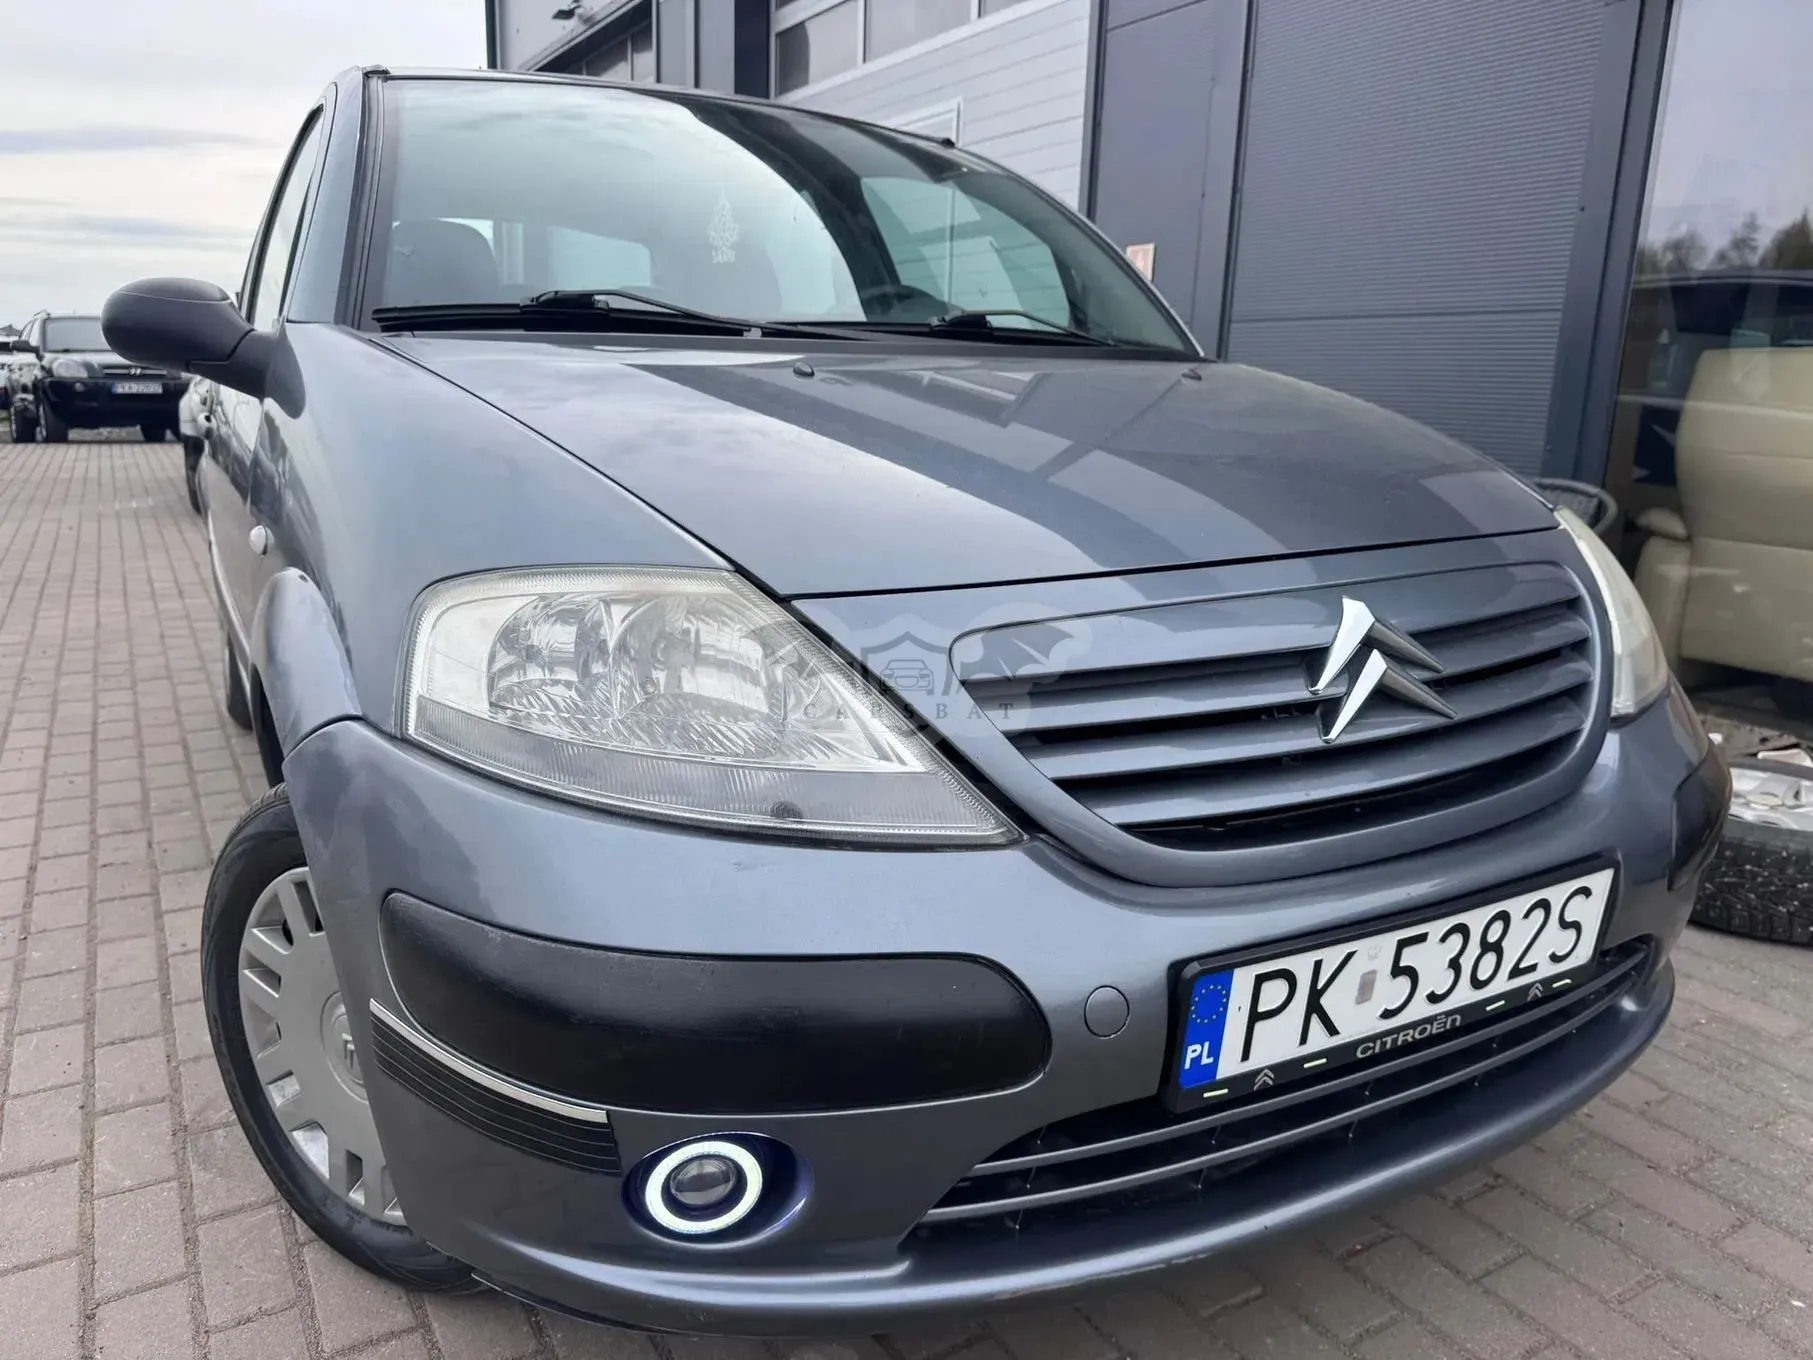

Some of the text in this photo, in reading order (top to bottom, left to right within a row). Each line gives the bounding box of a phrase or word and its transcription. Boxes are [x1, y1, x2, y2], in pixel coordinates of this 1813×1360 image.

[1240, 886, 1593, 1063] PK 5382S
[1184, 1041, 1214, 1070] PL
